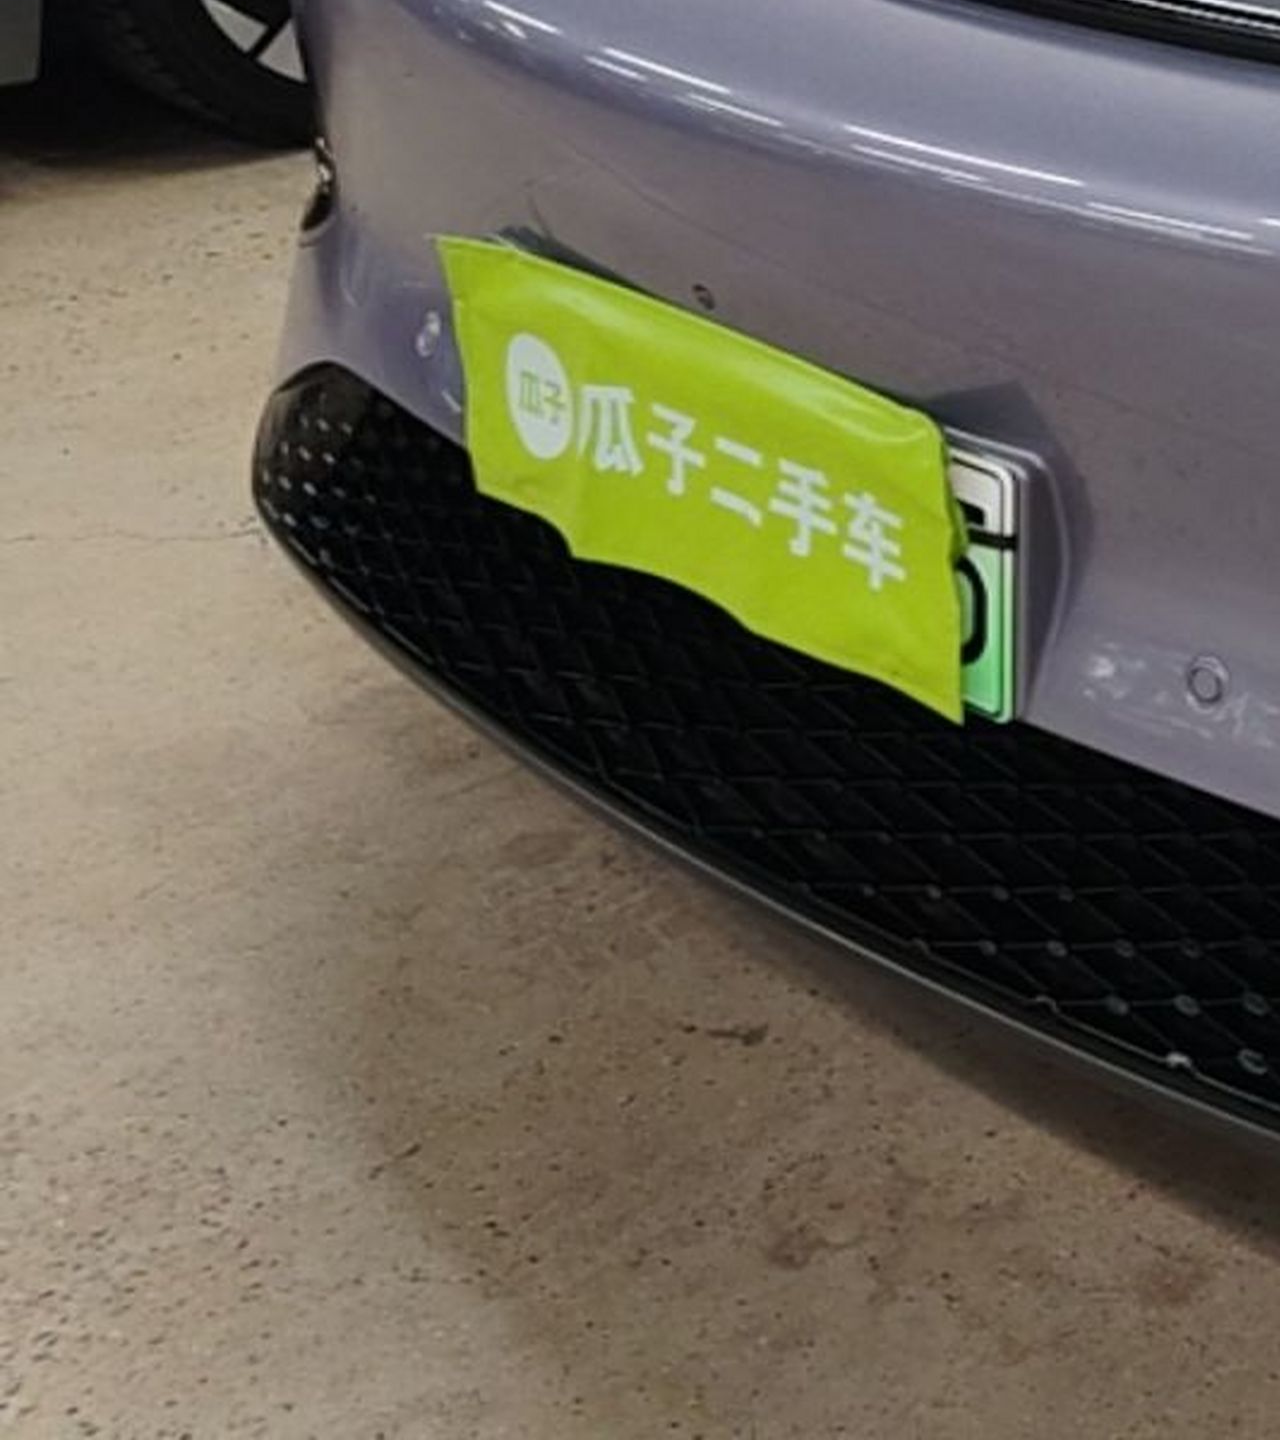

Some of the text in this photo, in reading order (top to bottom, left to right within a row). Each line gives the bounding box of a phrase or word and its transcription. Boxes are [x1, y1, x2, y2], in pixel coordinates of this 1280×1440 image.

[576, 383, 907, 591] 瓜子二手车
